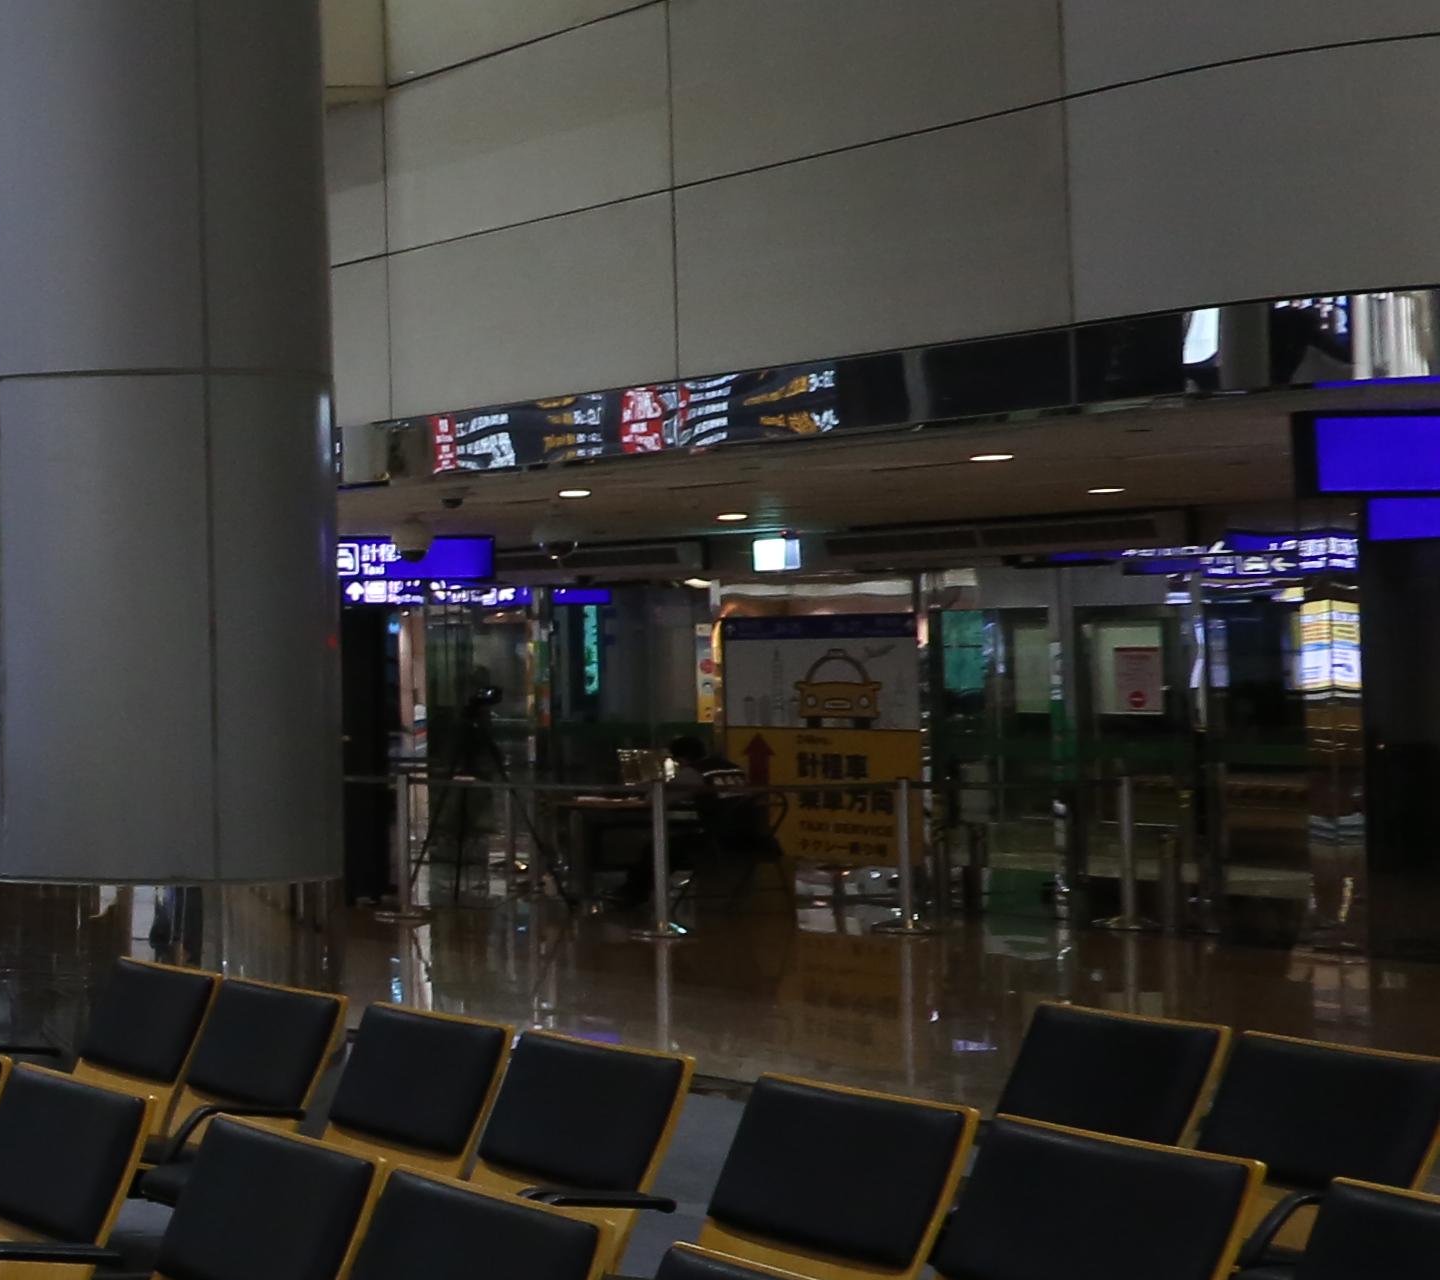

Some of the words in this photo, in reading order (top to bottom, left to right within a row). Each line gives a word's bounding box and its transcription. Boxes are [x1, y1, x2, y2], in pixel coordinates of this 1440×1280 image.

[361, 543, 402, 562] 計程
[361, 563, 385, 575] Taxi
[797, 752, 867, 778] 計程車
[799, 820, 829, 833] TAXI
[834, 822, 894, 837] SERVICE
